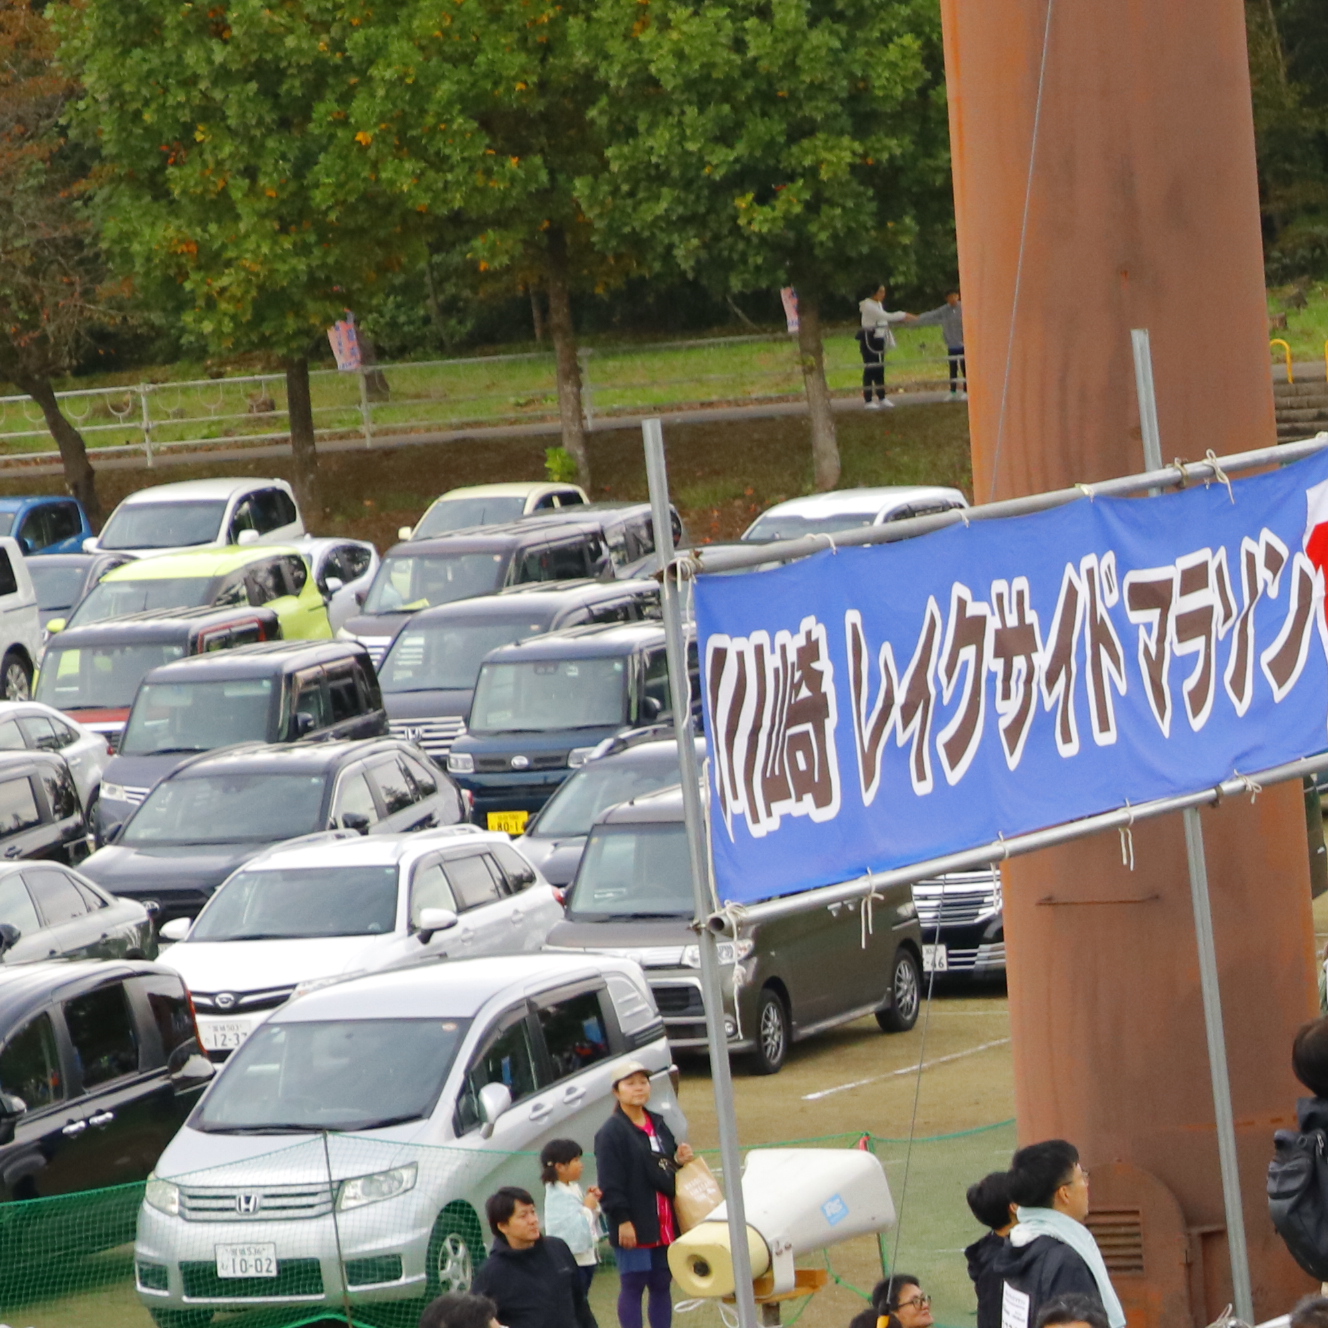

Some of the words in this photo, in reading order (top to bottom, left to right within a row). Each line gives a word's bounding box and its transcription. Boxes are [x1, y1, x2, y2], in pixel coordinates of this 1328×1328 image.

[708, 528, 1315, 843] 川崎レイクサイドマラソン
[232, 1258, 273, 1274] 10-02
